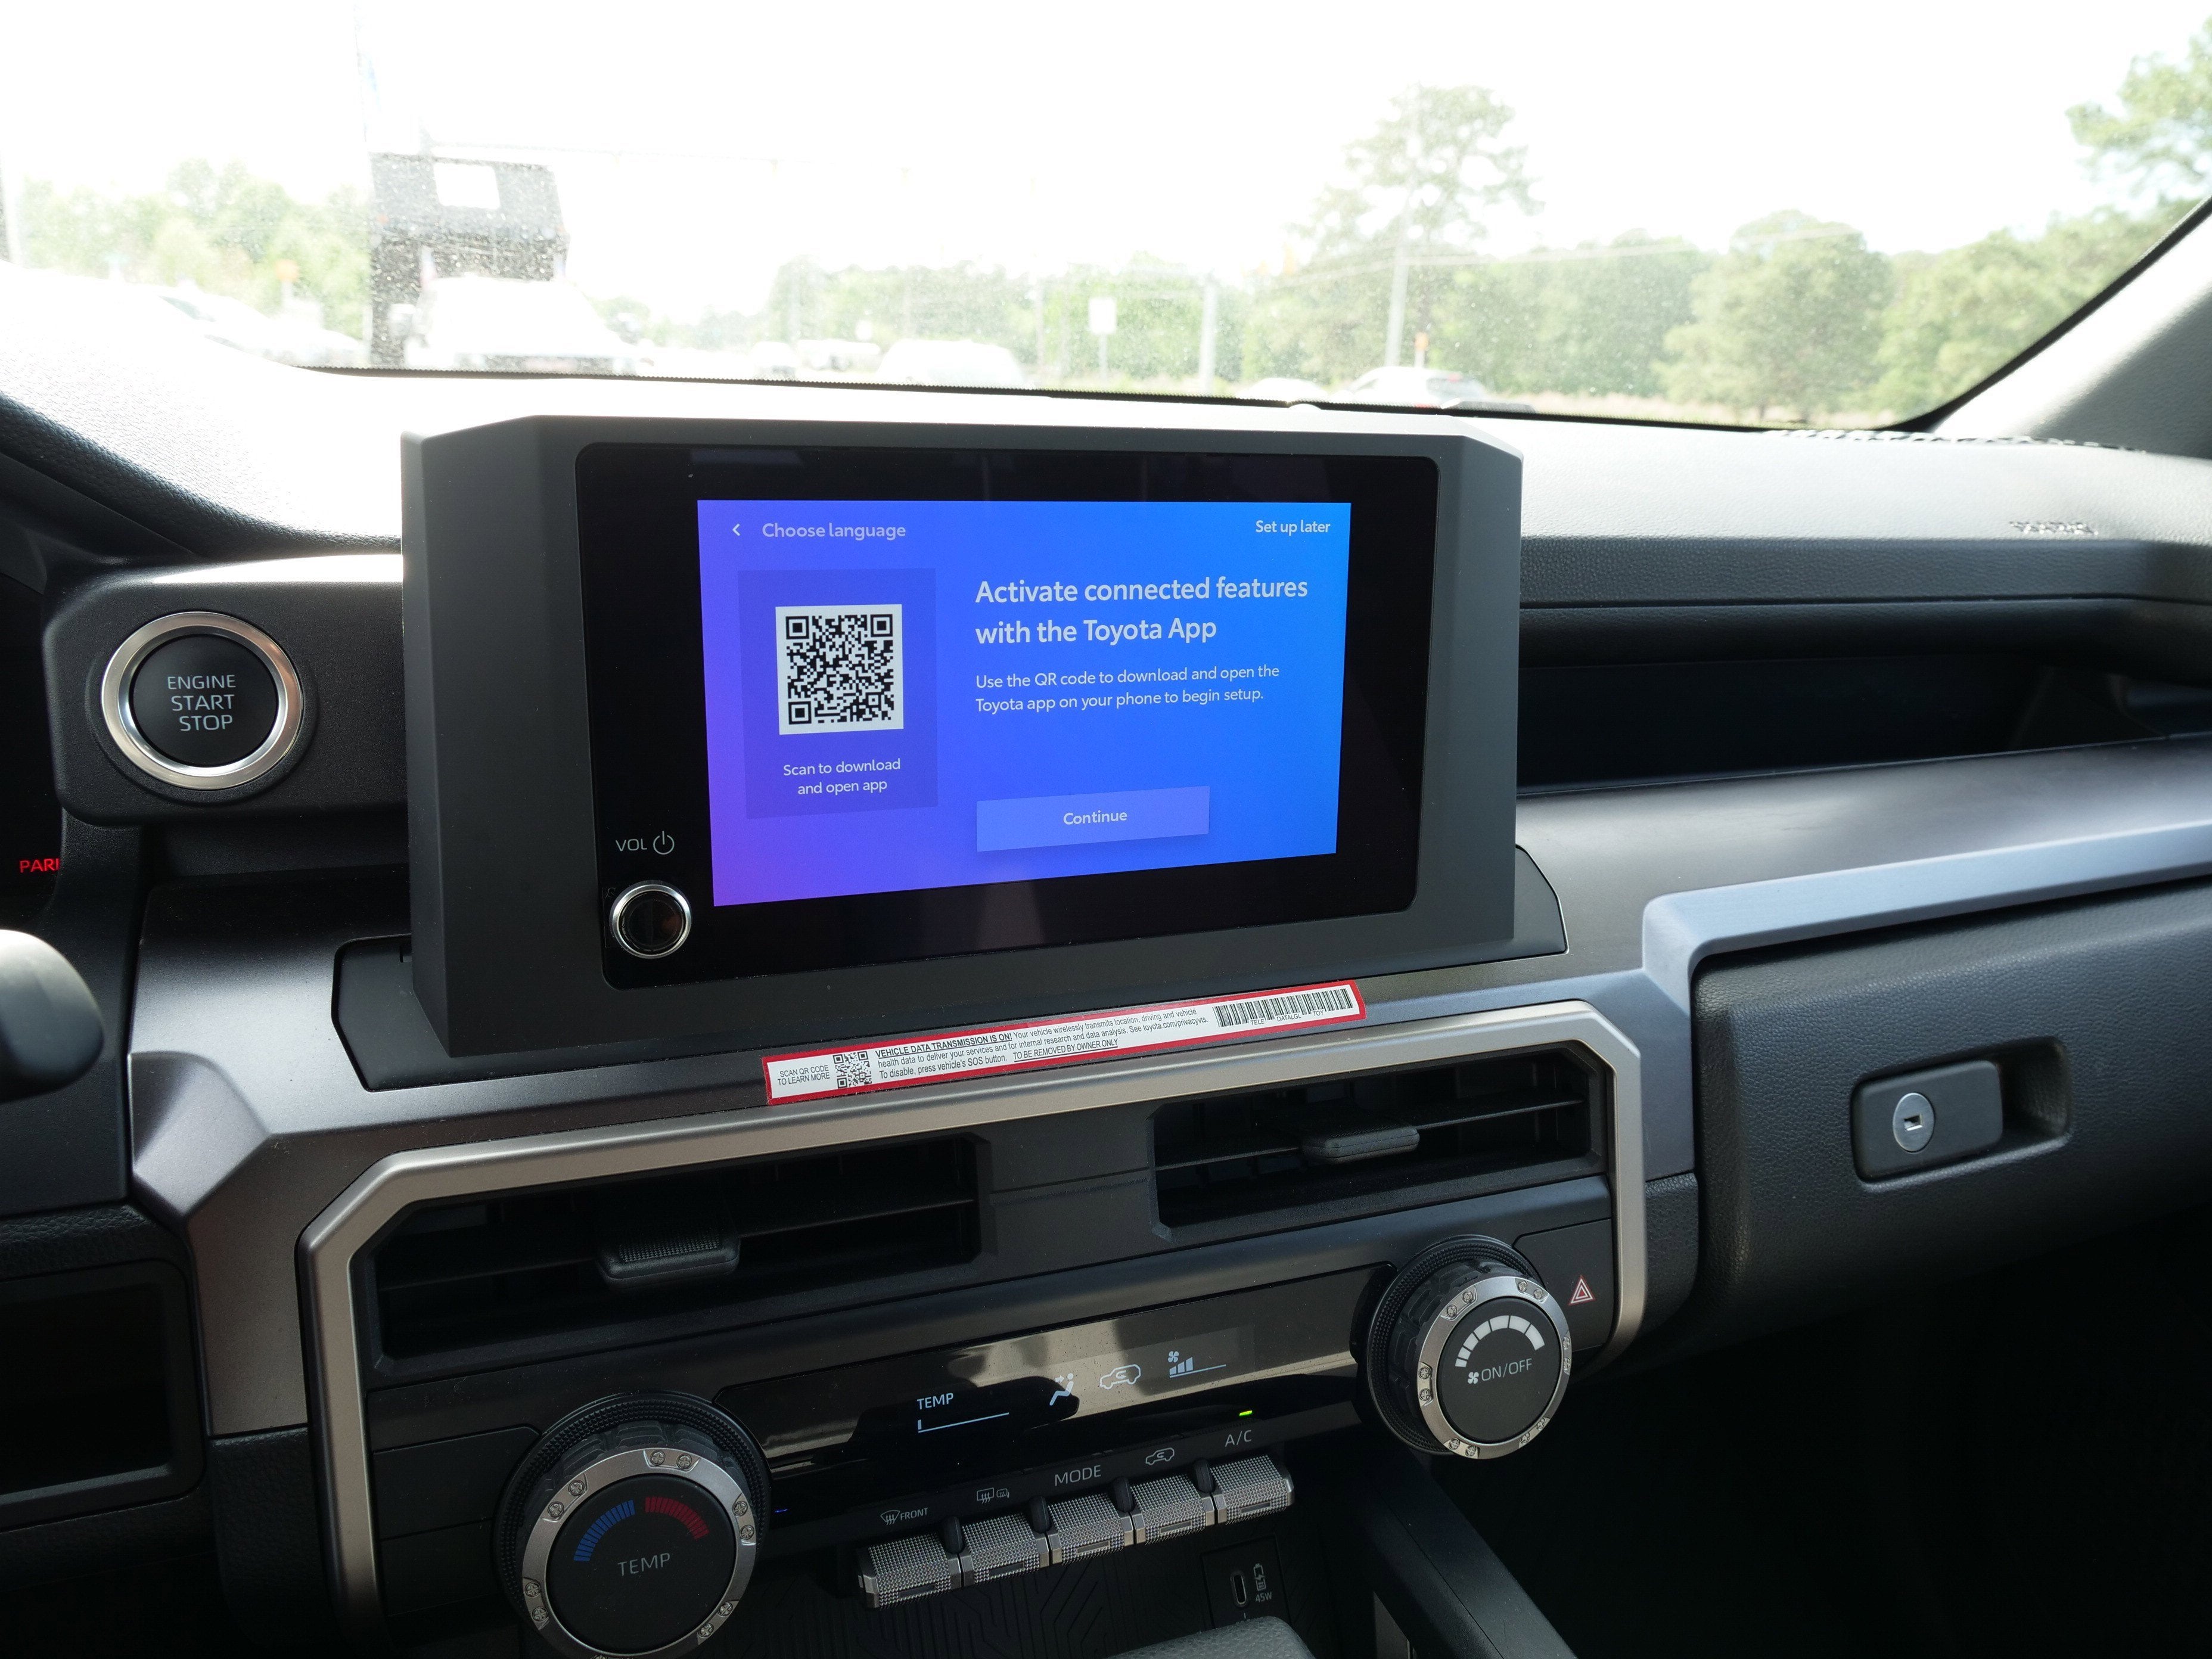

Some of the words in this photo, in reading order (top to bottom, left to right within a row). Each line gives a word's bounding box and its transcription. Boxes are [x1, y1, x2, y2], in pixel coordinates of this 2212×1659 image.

[762, 523, 825, 538] Choose
[829, 523, 906, 540] language
[1256, 520, 1276, 533] Set
[1280, 523, 1297, 536] up
[1300, 520, 1330, 533] later
[975, 580, 1078, 602] Activate
[1085, 577, 1210, 601] connected
[1216, 576, 1307, 598] features
[975, 621, 1030, 644] with
[1037, 620, 1077, 641] the
[1083, 619, 1162, 645] Toyota
[1168, 618, 1216, 643] App
[167, 675, 235, 689] ENGINE
[976, 675, 1003, 689] Use
[1006, 673, 1030, 688] the
[1034, 673, 1057, 686] QR
[1060, 671, 1095, 685] code
[1099, 672, 1114, 684] to
[1117, 668, 1187, 684] download
[1191, 666, 1217, 681] and
[1220, 667, 1254, 682] open
[1257, 664, 1279, 678] the
[171, 694, 235, 712] START
[975, 698, 1024, 714] Toyota
[1027, 699, 1055, 712] app
[1059, 698, 1077, 709] on
[1082, 696, 1113, 710] your
[1116, 691, 1161, 708] phone
[1164, 692, 1178, 704] to
[1182, 689, 1219, 705] begin
[1224, 688, 1263, 703] setup.
[179, 714, 233, 732] STOP
[783, 763, 815, 776] Scan
[818, 763, 832, 774] to
[835, 758, 900, 773] download
[797, 782, 822, 795] and
[826, 781, 859, 796] open
[863, 779, 887, 793] app
[1063, 810, 1127, 825] Continue
[616, 838, 648, 852] VOL
[875, 1046, 909, 1058] VEHICLE
[911, 1043, 930, 1053] DATA
[931, 1036, 989, 1049] TRANSMISSION
[999, 1033, 1012, 1041] ON!
[1030, 1028, 1052, 1037] vehicle
[1053, 1023, 1083, 1033] wirelessly
[1085, 1020, 1113, 1029] transmits
[1141, 1014, 1161, 1022] driving
[1176, 1008, 1197, 1017] vehicle
[878, 1058, 899, 1068] health
[901, 1057, 916, 1065] data
[926, 1051, 948, 1061] deliver
[949, 1051, 964, 1059] your
[966, 1046, 993, 1056] services
[995, 1043, 1007, 1052] and
[1018, 1039, 1042, 1048] internal
[1044, 1034, 1071, 1045] research
[1073, 1032, 1085, 1040] and
[1101, 1028, 1128, 1036] analysis.
[1143, 1017, 1208, 1032] toyota.com/privacyvts.
[879, 1070, 888, 1079] To
[890, 1067, 916, 1077] disable,
[918, 1065, 936, 1075] press
[937, 1060, 966, 1071] vehicle's
[968, 1057, 983, 1067] SOS
[984, 1055, 1007, 1064] button.
[1034, 1046, 1065, 1057] REMOVED
[1077, 1041, 1101, 1051] OWNER
[1102, 1038, 1118, 1047] ONLY
[779, 1069, 797, 1077] SCAN
[788, 1075, 809, 1085] LEARN
[811, 1073, 830, 1082] MORE
[1481, 1358, 1532, 1382] ON/OFF
[917, 1393, 953, 1410] TEMP
[1225, 1430, 1252, 1447] A/C
[1054, 1465, 1101, 1486] MODE
[900, 1507, 928, 1521] FRONT
[617, 1553, 670, 1577] TEMP
[1255, 1591, 1273, 1603] 45W
